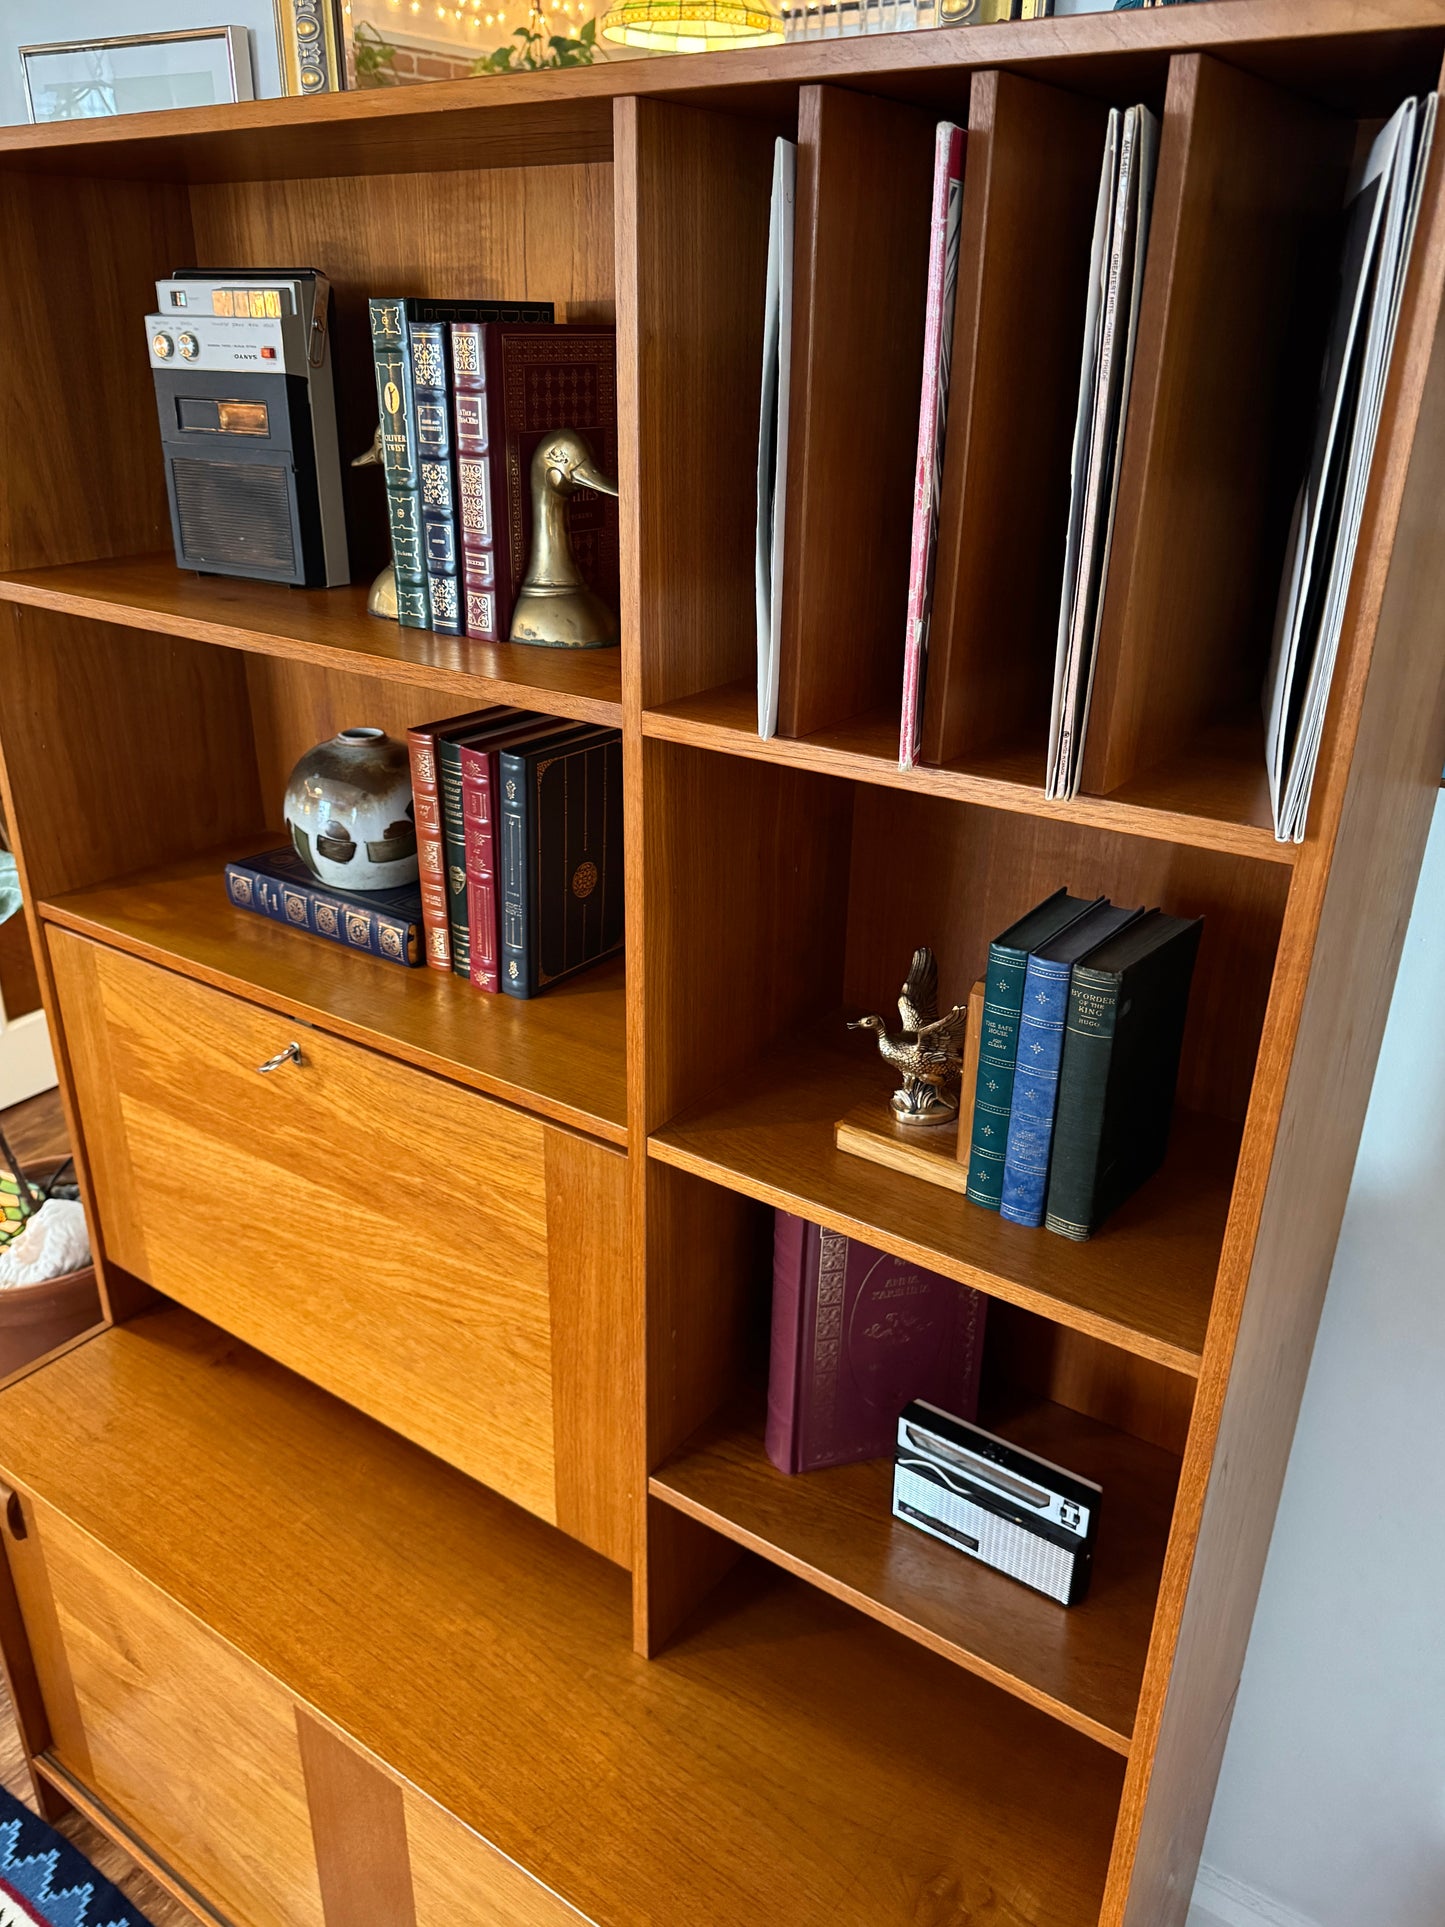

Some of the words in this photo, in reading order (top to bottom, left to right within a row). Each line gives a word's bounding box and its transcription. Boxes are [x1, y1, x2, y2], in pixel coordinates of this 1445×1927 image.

[1110, 253, 1120, 296] GREATEST
[1104, 322, 1113, 358] CHARLEY
[384, 434, 407, 443] OLIVER
[386, 443, 406, 453] TWIST
[1071, 988, 1083, 998] BY
[1083, 993, 1116, 1005] ORDER
[1078, 1005, 1103, 1017] KING
[1090, 1002, 1105, 1010] THE
[985, 1019, 997, 1028] THE
[997, 1023, 1014, 1033] SAFE
[1078, 1018, 1100, 1028] HUGO
[988, 1027, 1009, 1038] HOUSE
[987, 1040, 1007, 1050] CLEARY
